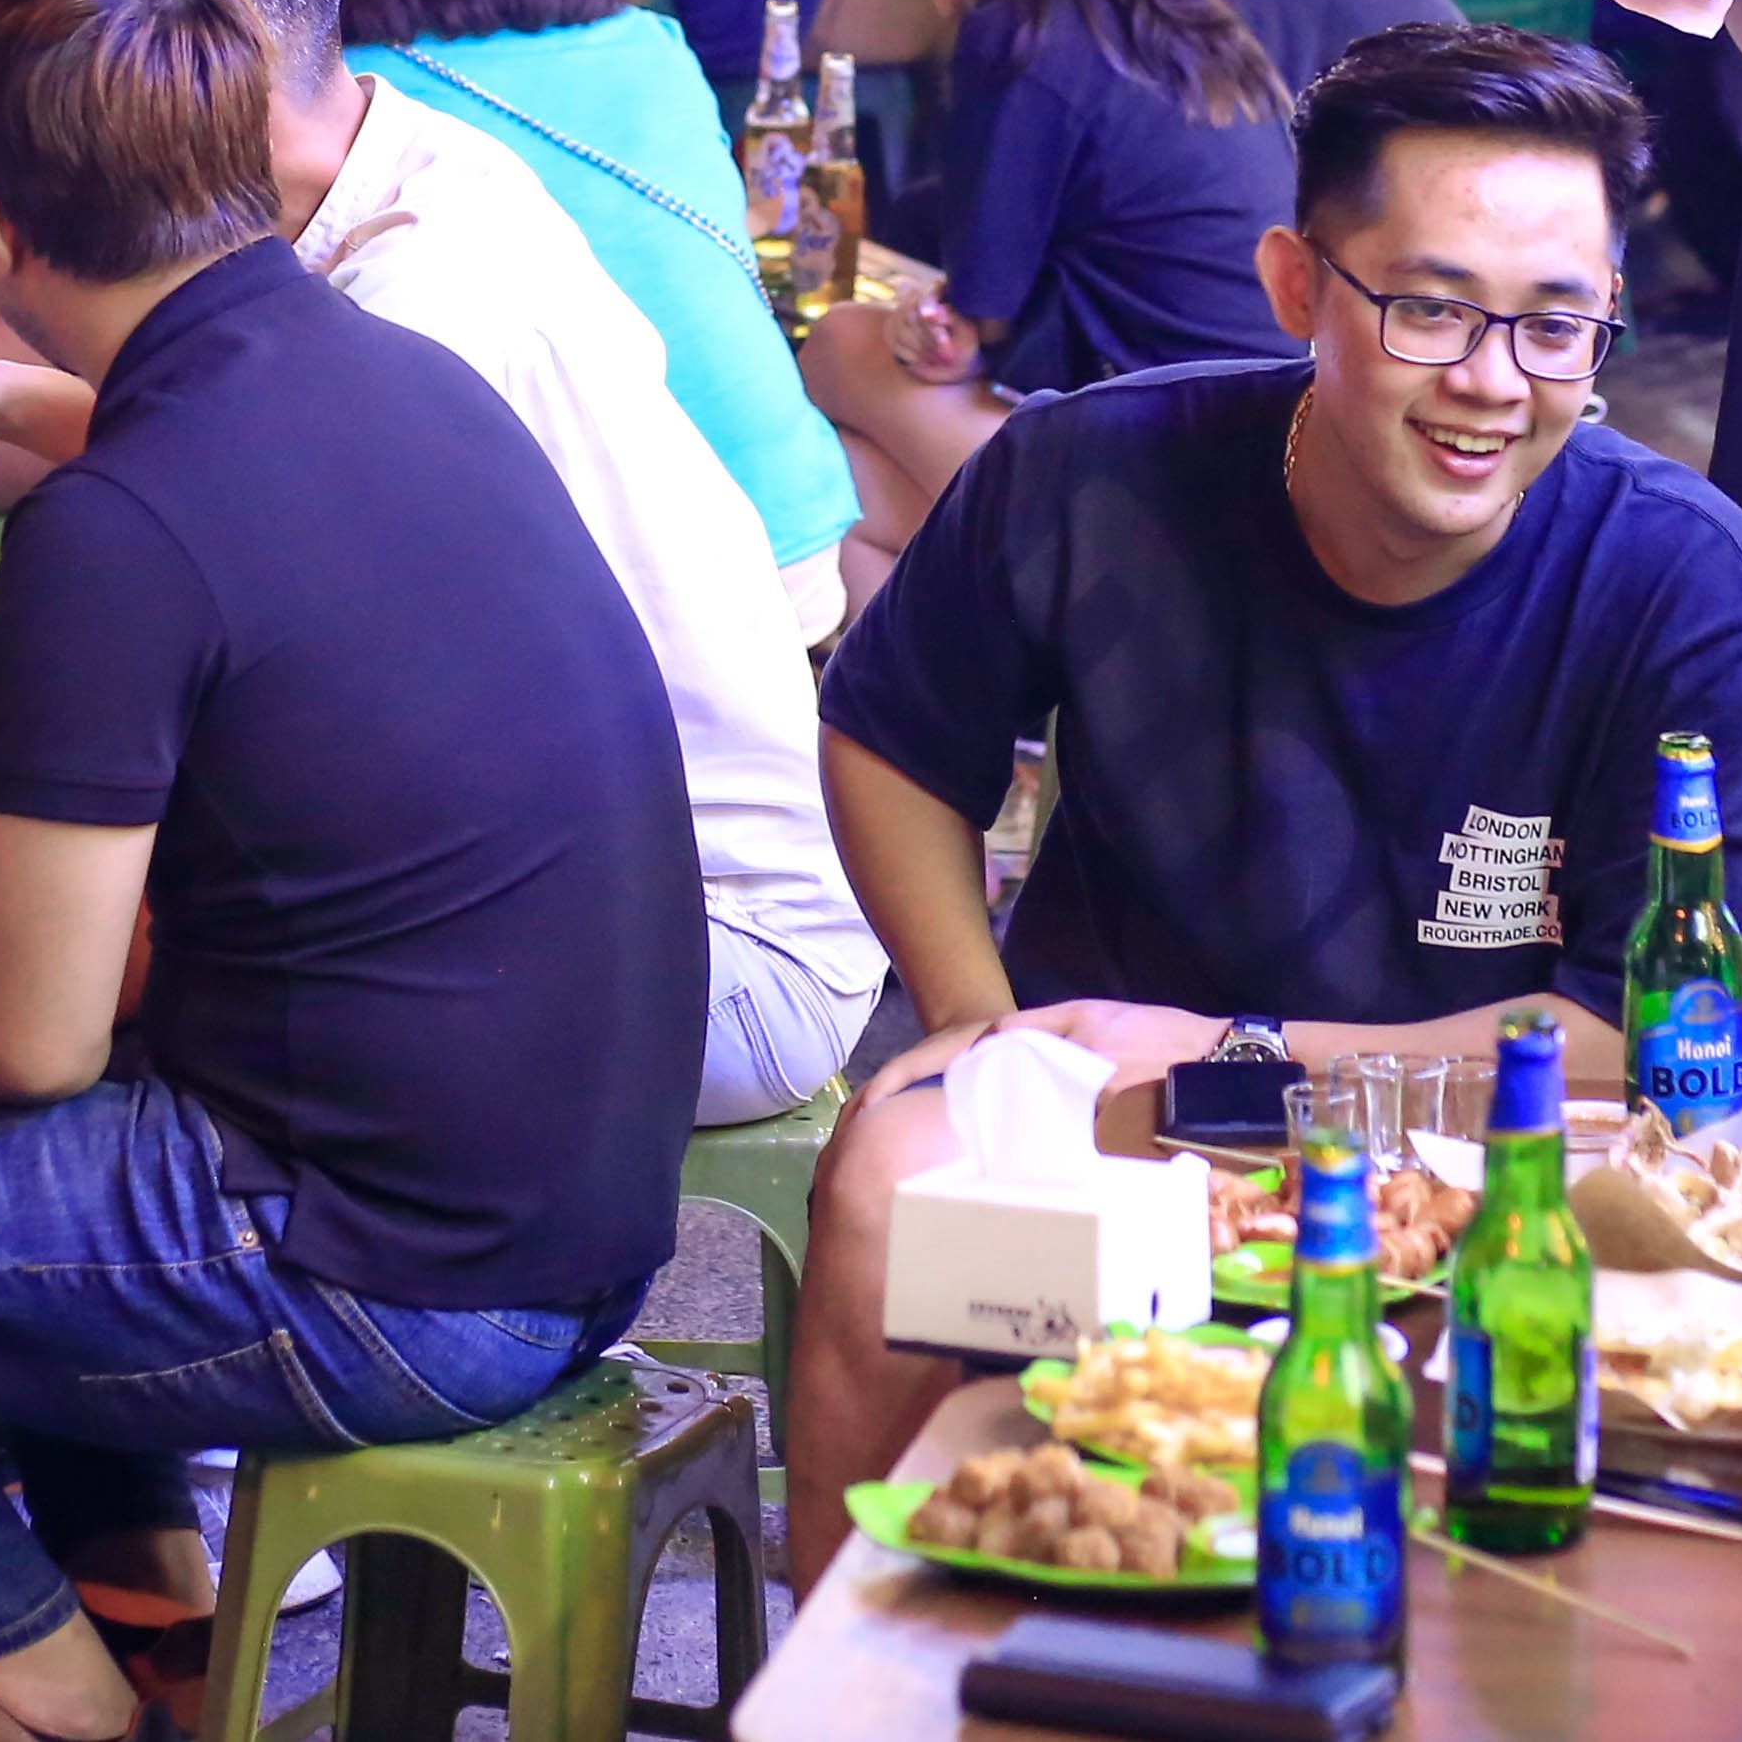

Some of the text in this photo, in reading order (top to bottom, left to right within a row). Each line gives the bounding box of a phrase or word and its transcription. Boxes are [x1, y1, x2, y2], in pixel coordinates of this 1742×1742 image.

[1469, 812, 1542, 840] LONDON
[1458, 870, 1541, 892] BRISTOL
[1444, 899, 1550, 919] NEW YORK
[1423, 925, 1562, 944] ROUGHTRADE.CO
[1676, 1033, 1732, 1062] Hanoi
